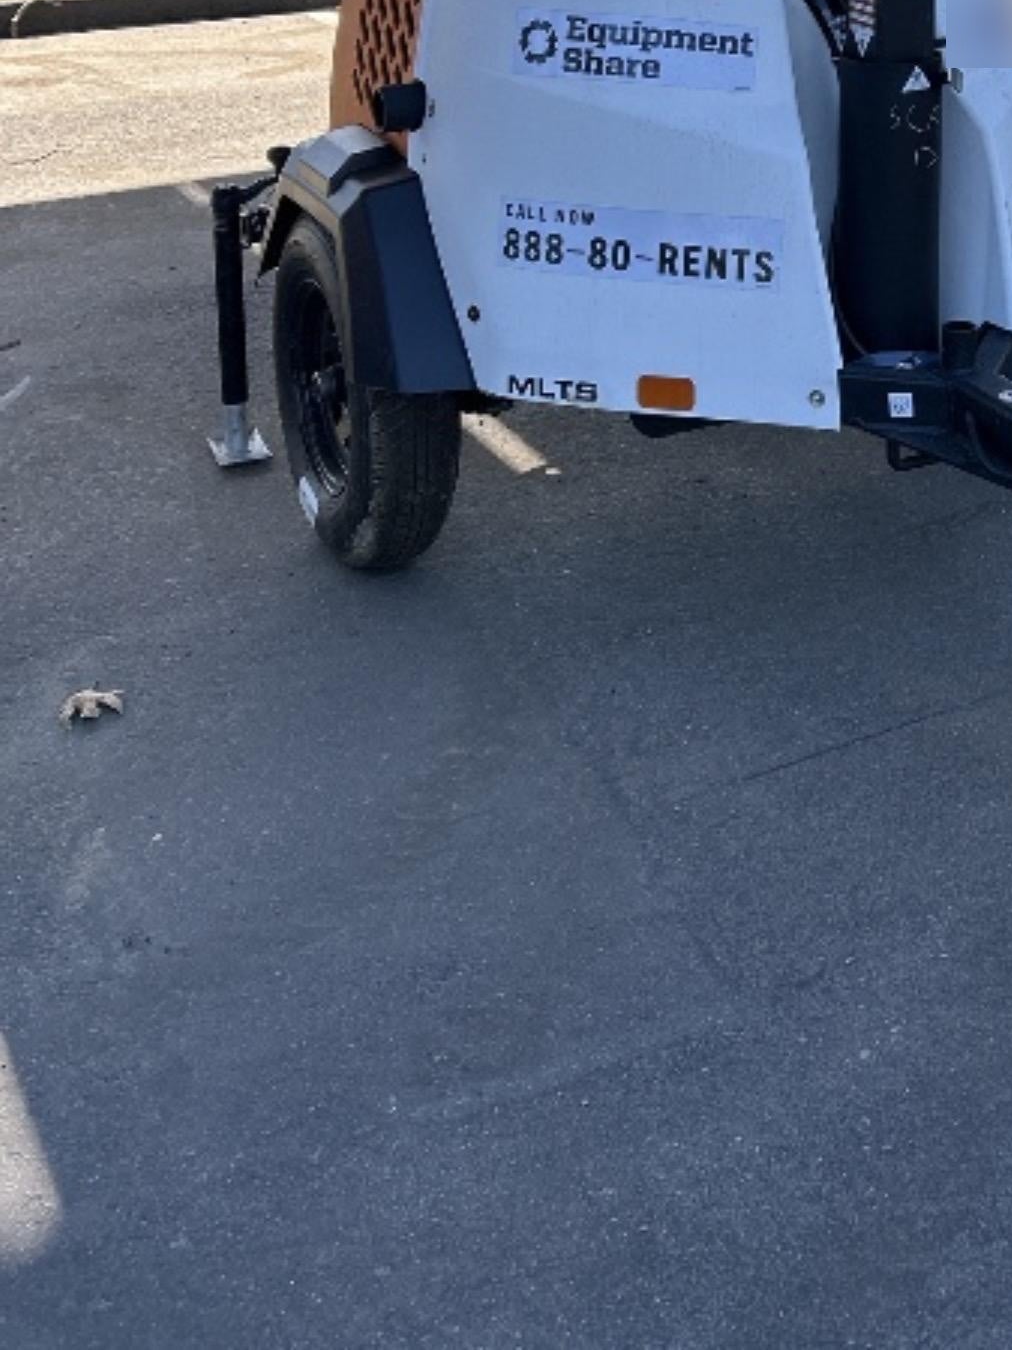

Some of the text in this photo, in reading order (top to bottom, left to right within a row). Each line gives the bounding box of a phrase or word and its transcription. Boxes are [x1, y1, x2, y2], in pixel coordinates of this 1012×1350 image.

[565, 15, 755, 57] Equipment
[562, 47, 661, 79] Share
[506, 203, 595, 226] CALL NOW
[503, 226, 775, 284] 888-80-RENTS
[508, 373, 599, 402] MLTS
